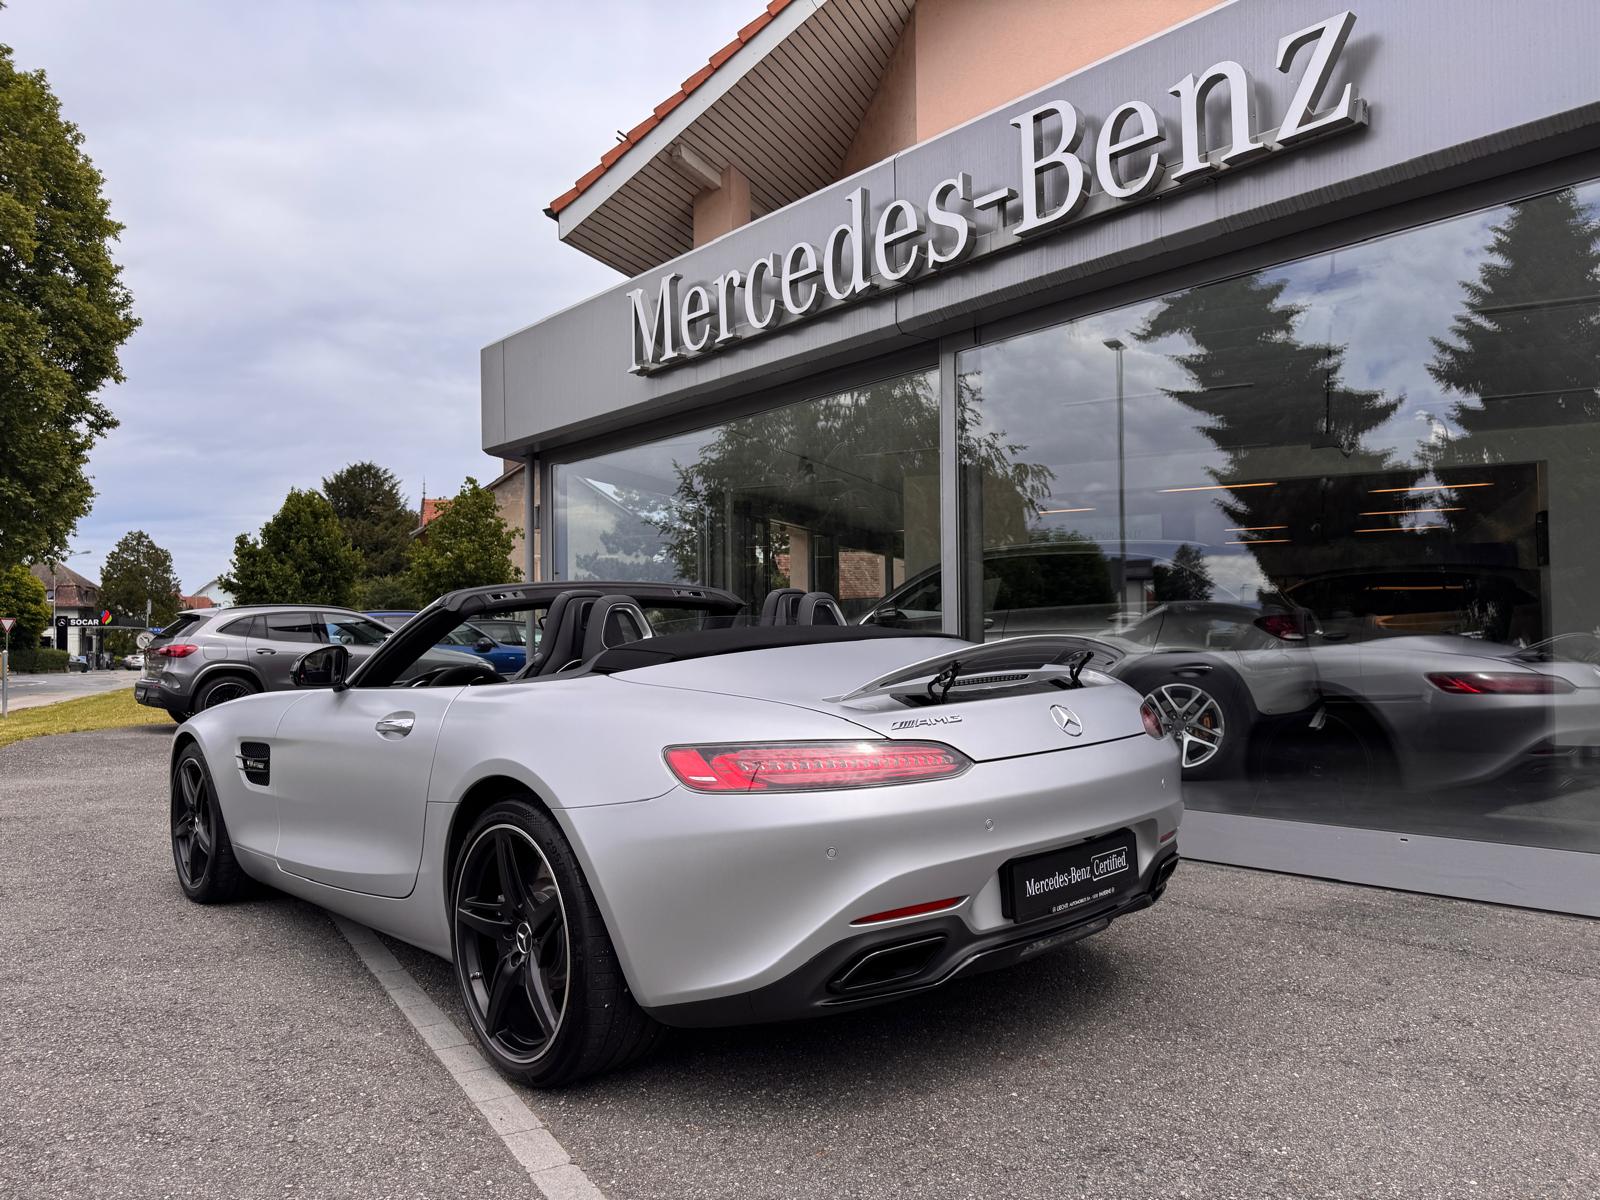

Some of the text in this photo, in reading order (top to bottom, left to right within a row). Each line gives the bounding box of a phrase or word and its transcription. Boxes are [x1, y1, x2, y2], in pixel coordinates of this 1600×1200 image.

[627, 10, 1358, 376] Mercedes-Benz
[912, 715, 963, 729] AMG
[1025, 851, 1126, 897] Mercedes-Benz Certified
